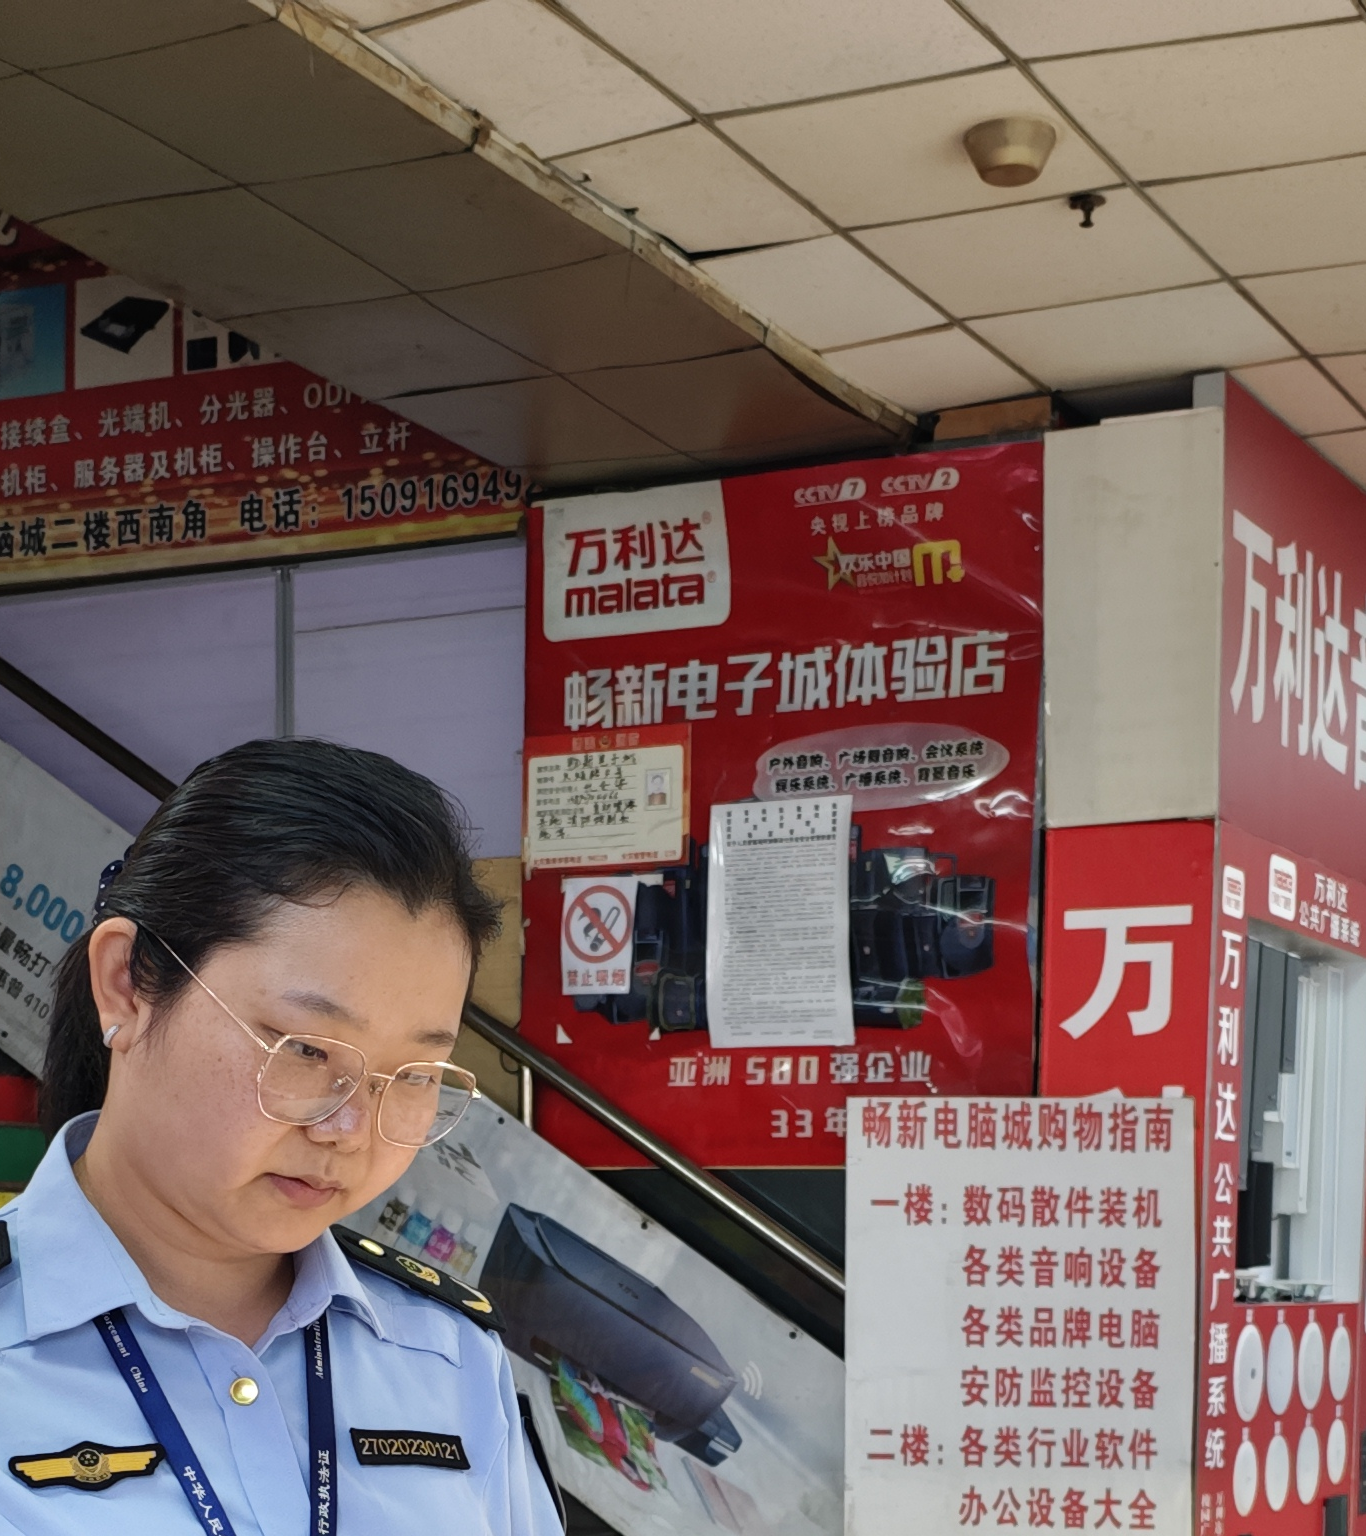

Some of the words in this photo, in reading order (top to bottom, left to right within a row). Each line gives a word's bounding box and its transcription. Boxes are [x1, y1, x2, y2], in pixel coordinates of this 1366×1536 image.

[564, 516, 706, 578] 万利达
[564, 576, 706, 618] malata
[562, 630, 1009, 733] 畅新电子城体验店
[565, 967, 627, 989] 禁止吸烟
[1059, 904, 1194, 1040] 万
[861, 1099, 1175, 1154] 畅新电脑城购物指南
[1203, 929, 1245, 1470] 万利达公共广播系统
[961, 1244, 1162, 1290] 各类音响设备
[960, 1304, 1161, 1350] 各类品牌电脑
[960, 1365, 1160, 1410] 安防监控设备
[358, 1436, 463, 1462] 27020230121
[958, 1485, 1158, 1531] 办公设备大全
